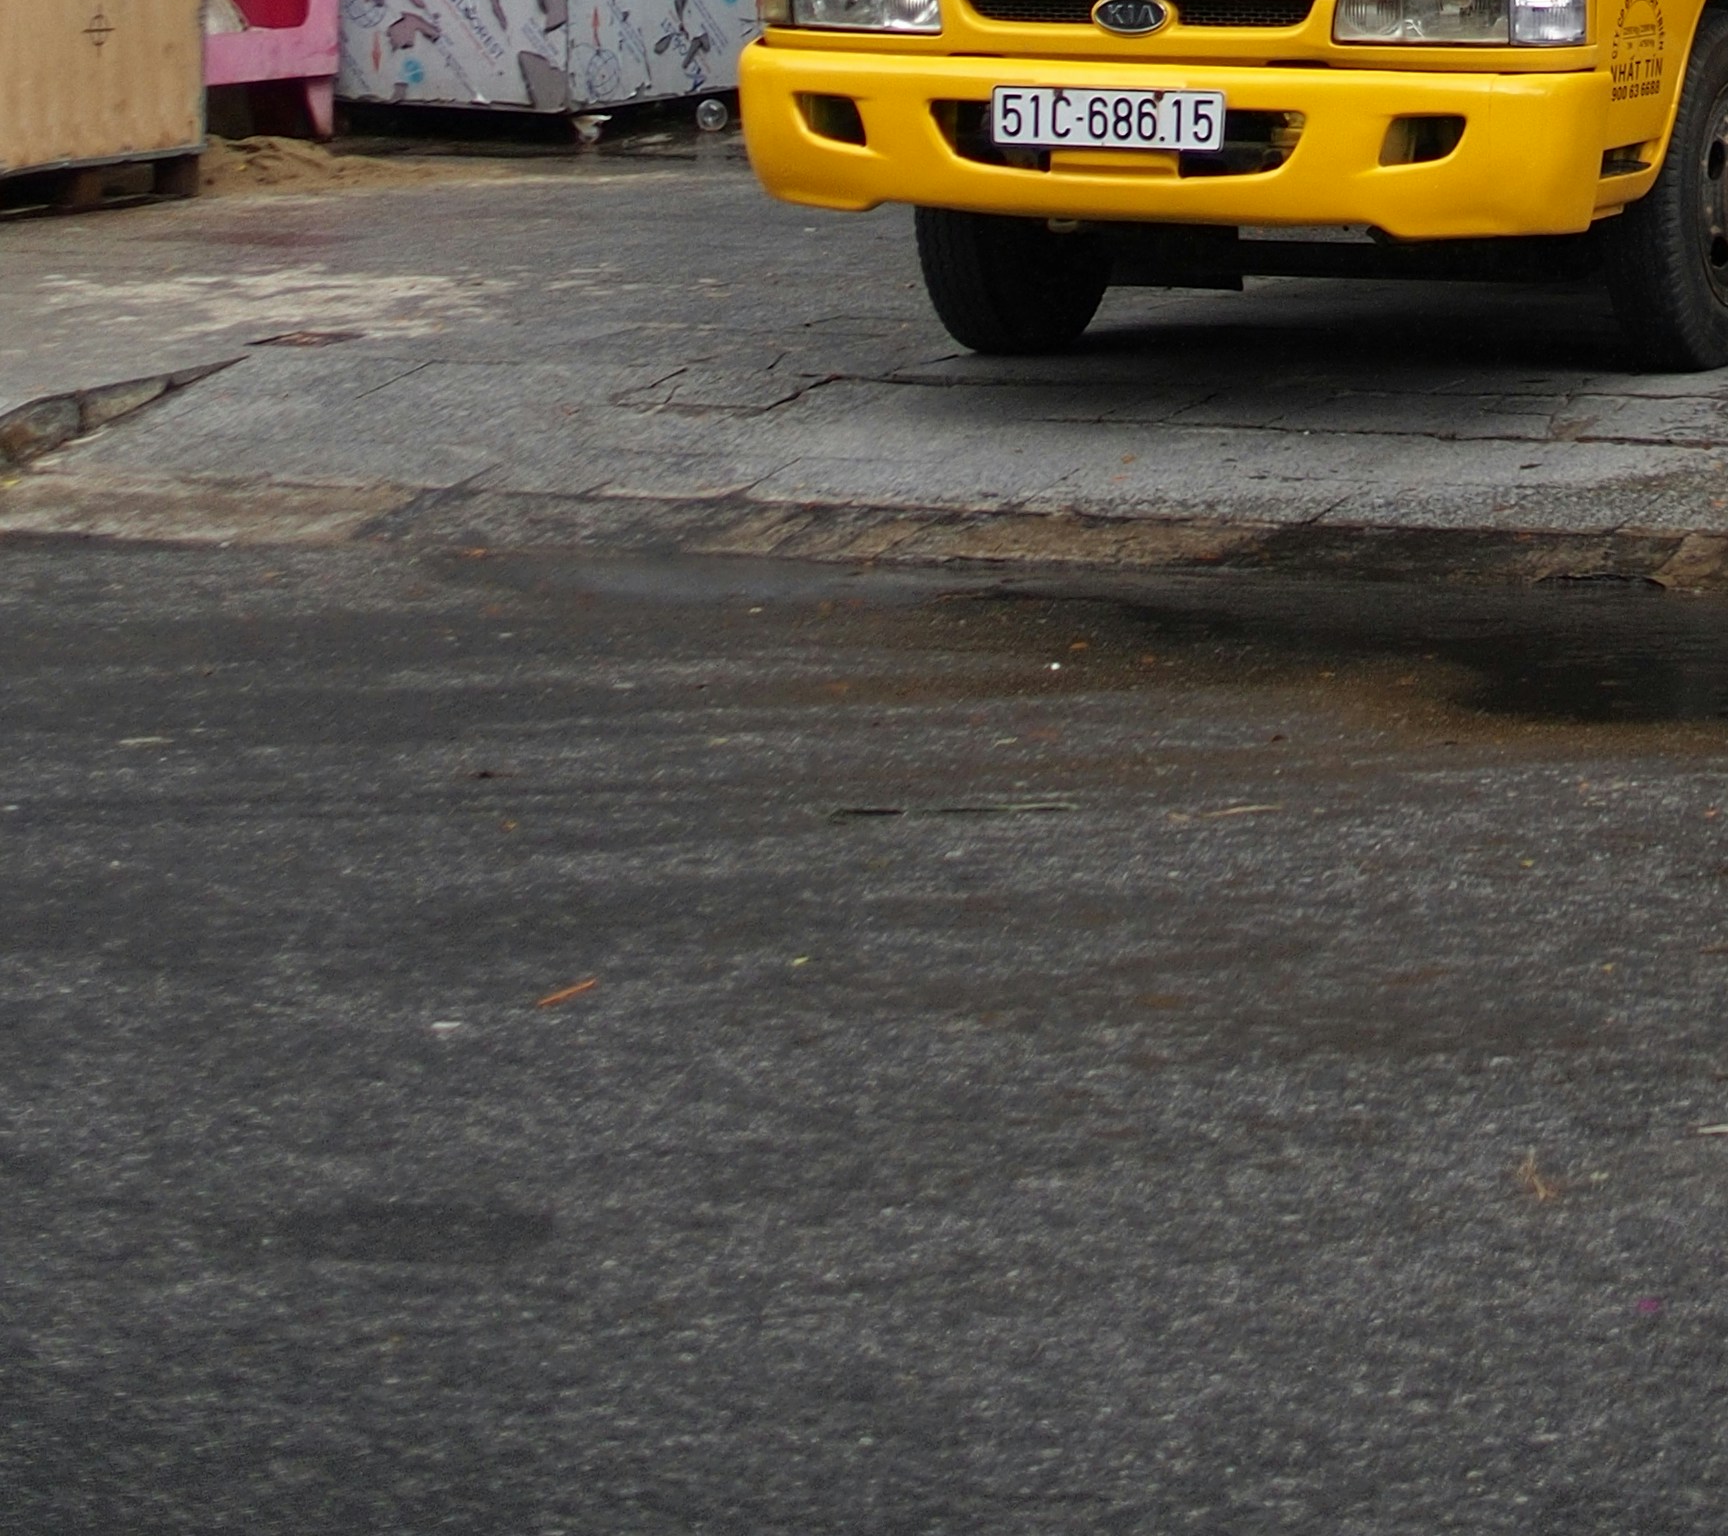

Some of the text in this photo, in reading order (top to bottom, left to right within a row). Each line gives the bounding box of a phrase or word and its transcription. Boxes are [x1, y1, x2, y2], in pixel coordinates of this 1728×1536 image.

[1106, 4, 1156, 24] KIA
[1645, 53, 1663, 78] TÍN
[1001, 94, 1214, 143] 51C-686.15
